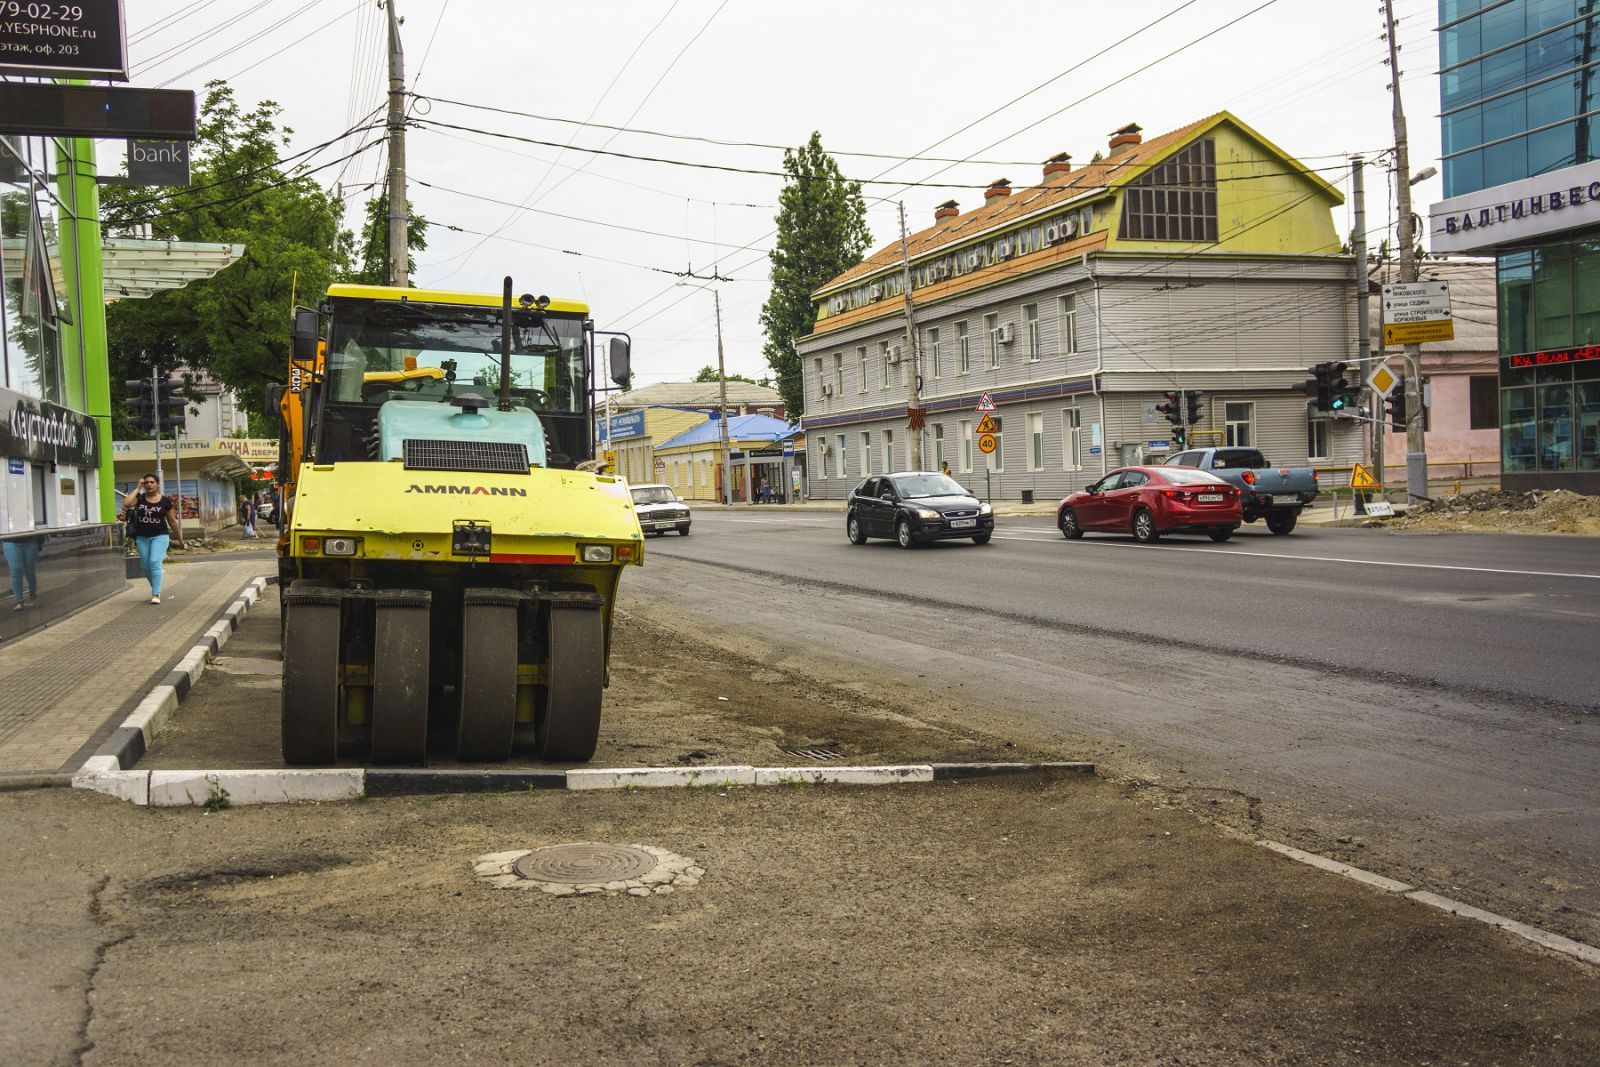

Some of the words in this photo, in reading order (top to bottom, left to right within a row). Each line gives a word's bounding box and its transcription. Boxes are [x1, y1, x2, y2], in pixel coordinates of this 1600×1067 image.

[35, 43, 55, 56] оф.
[58, 45, 79, 55] 203
[133, 142, 182, 162] bank
[982, 440, 993, 448] 40
[404, 485, 527, 497] AMMANN
[139, 504, 162, 513] PLAY
